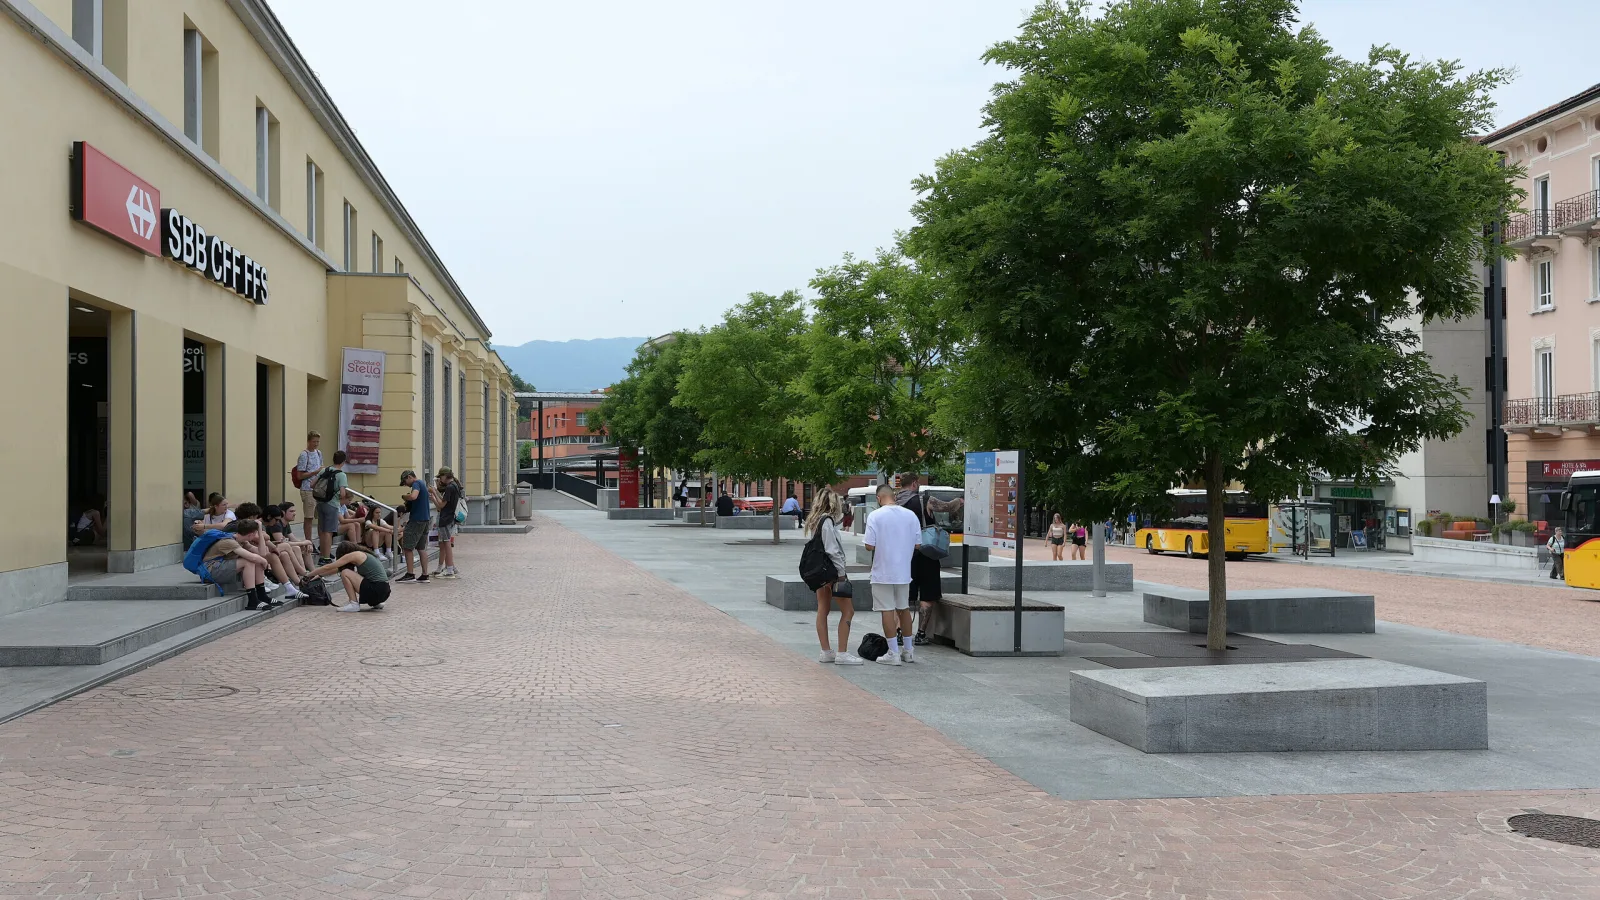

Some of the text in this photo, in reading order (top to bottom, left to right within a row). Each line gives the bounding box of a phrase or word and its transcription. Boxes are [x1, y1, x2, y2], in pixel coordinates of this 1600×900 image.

[168, 208, 269, 305] SBB CFF FFS
[347, 362, 380, 374] Stella
[347, 384, 367, 394] Shop
[1330, 487, 1374, 499] FARMACIA
